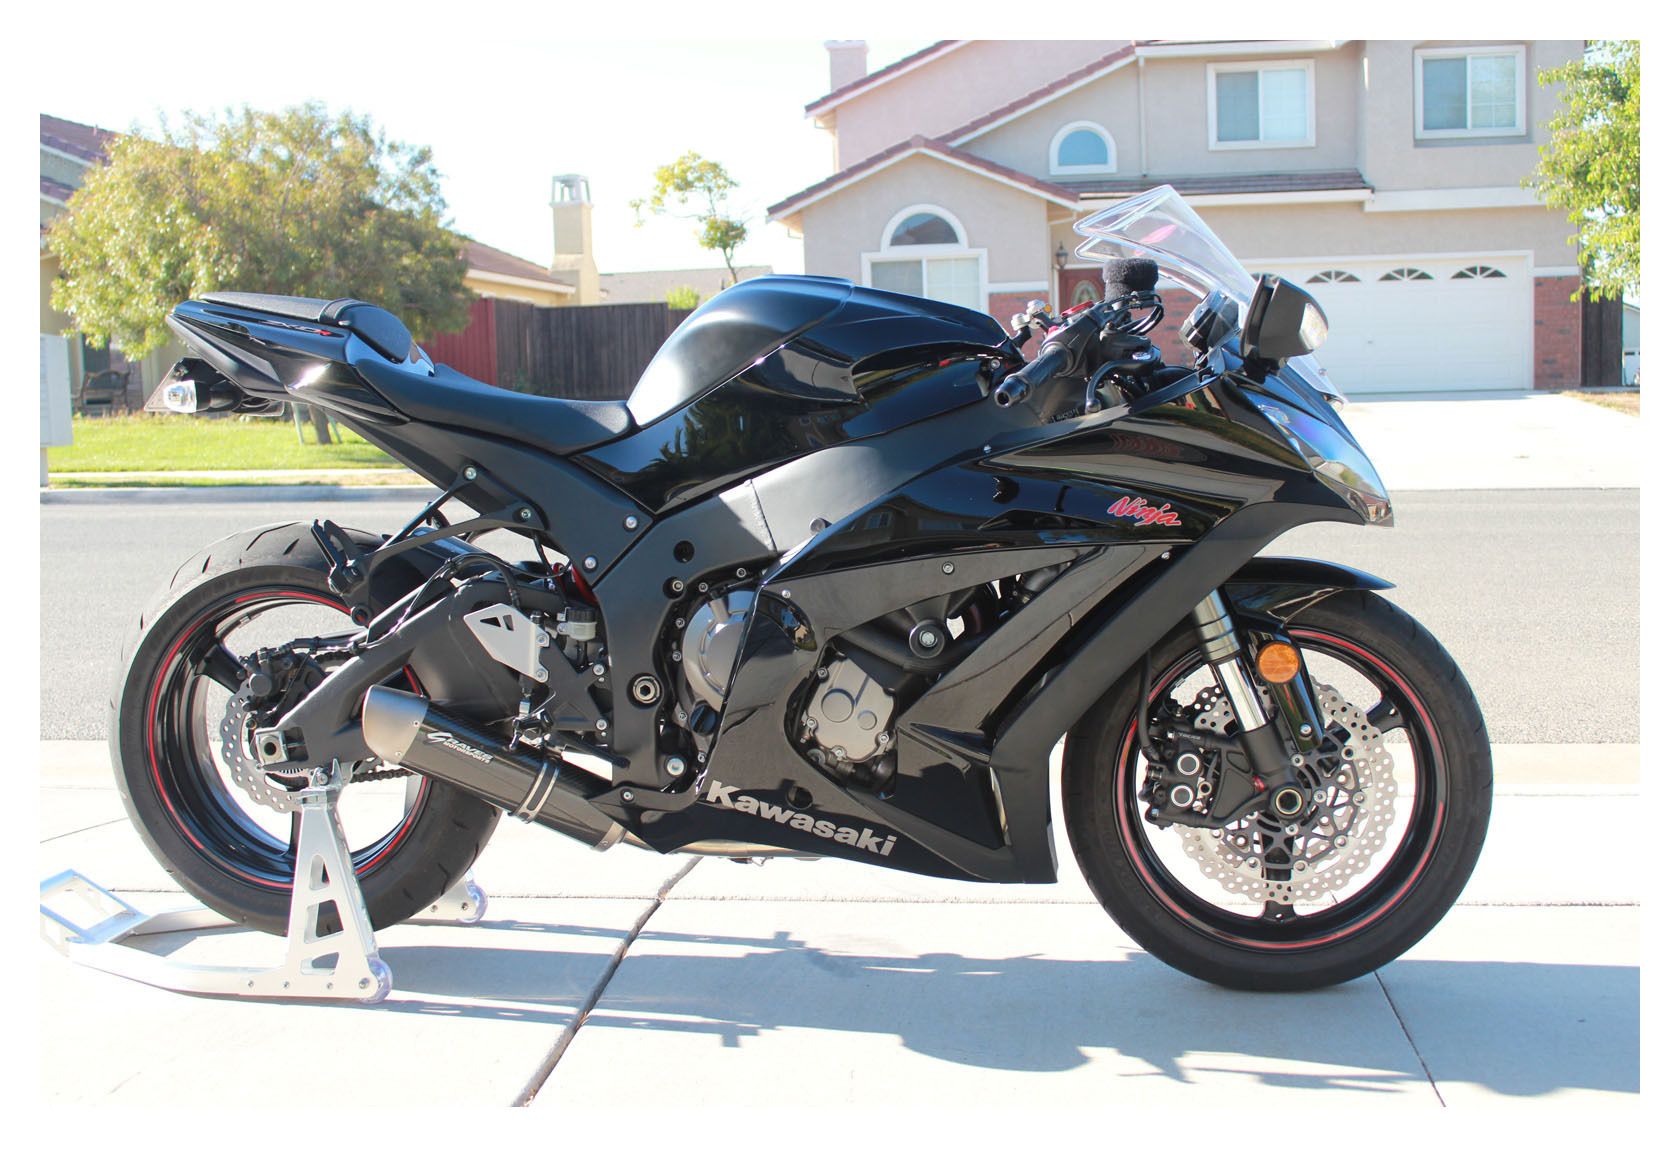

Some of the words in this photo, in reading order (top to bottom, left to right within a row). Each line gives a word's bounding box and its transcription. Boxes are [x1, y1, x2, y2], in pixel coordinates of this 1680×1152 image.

[1107, 496, 1182, 526] Ninja
[427, 731, 494, 760] GRAVES
[442, 741, 492, 764] MOTORSPORTS
[706, 780, 897, 856] Kawasaki
